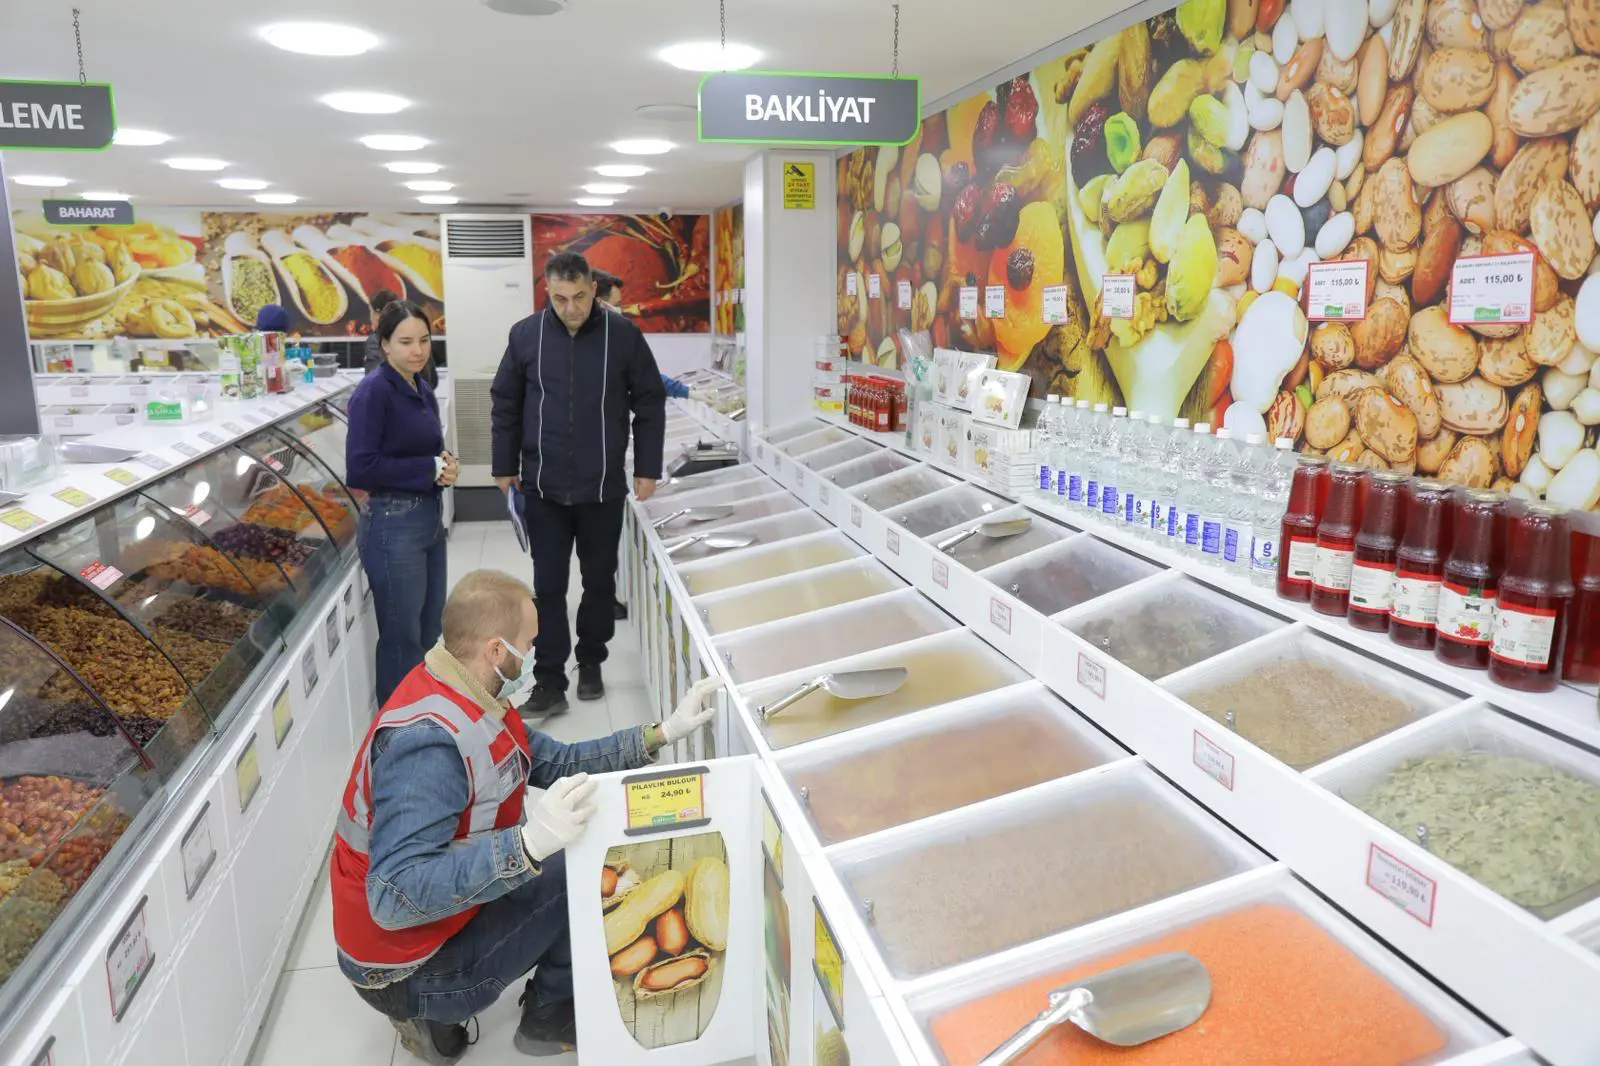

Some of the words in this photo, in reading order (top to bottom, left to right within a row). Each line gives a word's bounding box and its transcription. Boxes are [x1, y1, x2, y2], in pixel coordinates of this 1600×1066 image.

[745, 89, 876, 124] BAKLİYAT
[59, 207, 117, 218] BAHARAT
[1484, 274, 1514, 285] 115,00
[631, 780, 665, 791] PİLAVLIK
[667, 776, 697, 786] BULGUR
[660, 788, 684, 798] 24,90
